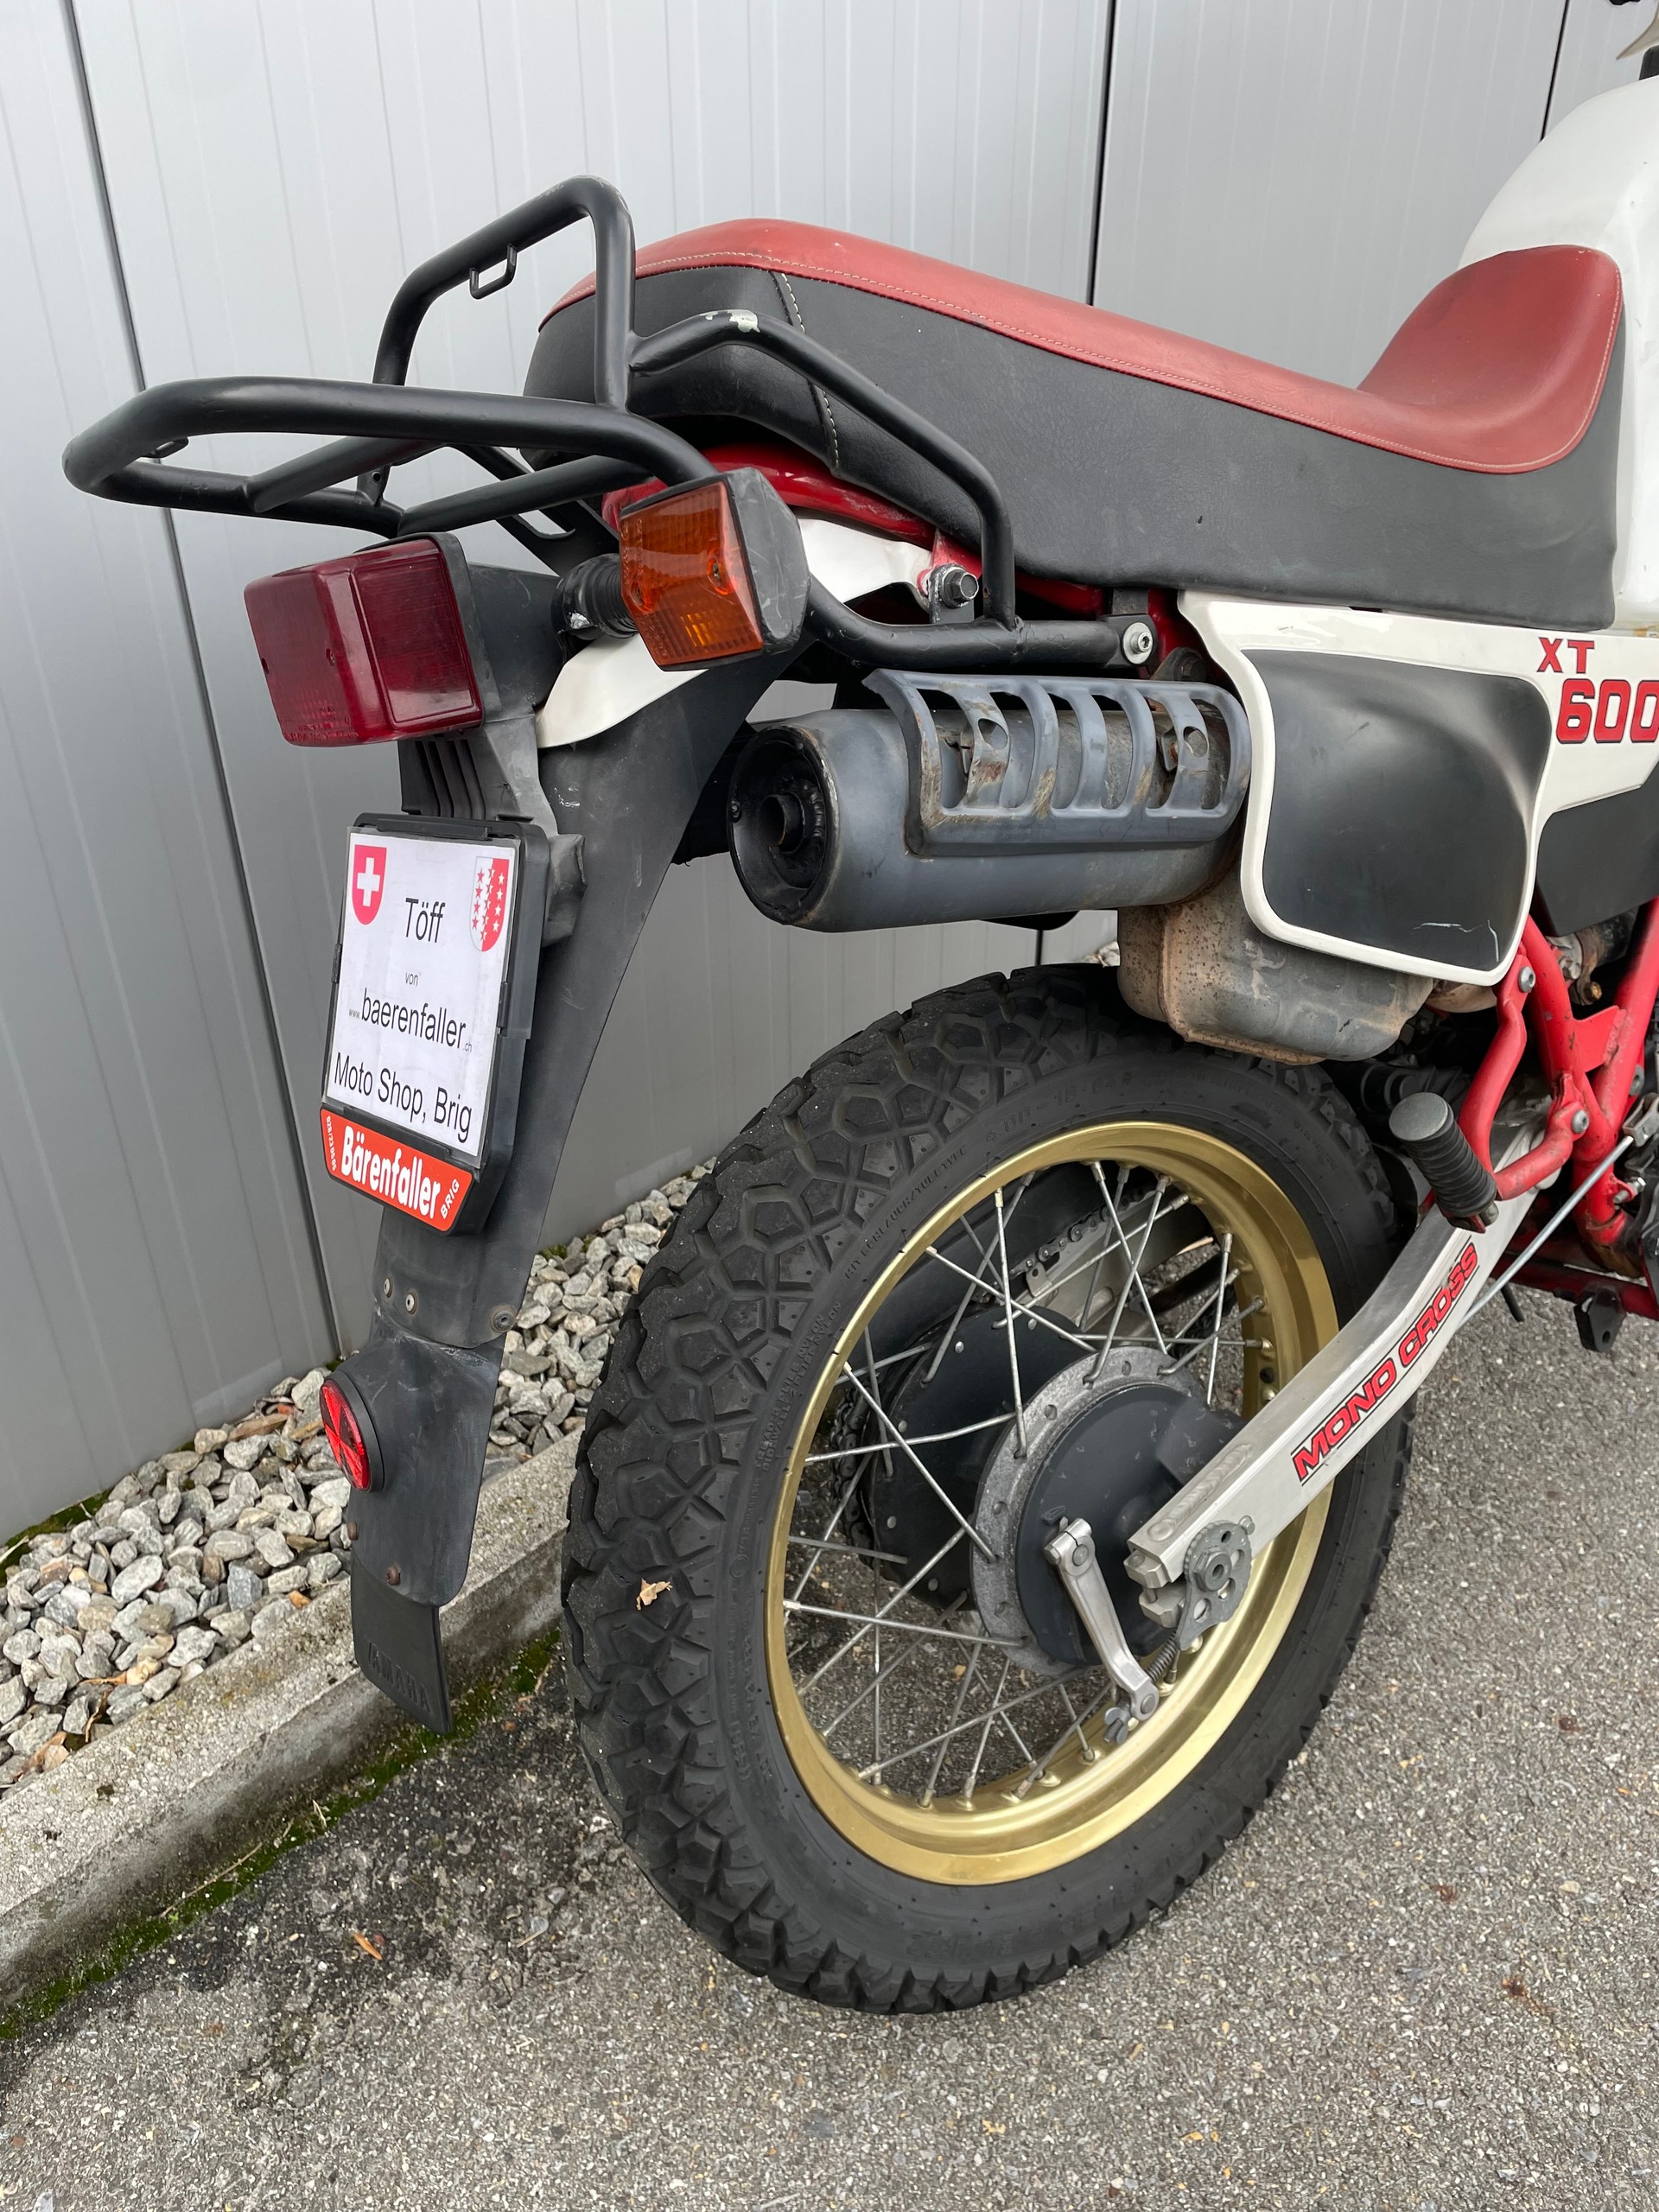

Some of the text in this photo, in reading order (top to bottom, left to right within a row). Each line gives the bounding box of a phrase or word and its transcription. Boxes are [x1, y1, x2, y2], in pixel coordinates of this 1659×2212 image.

[1536, 637, 1595, 674] XT
[1556, 677, 1659, 744] 600
[405, 897, 445, 944] Töff
[405, 972, 419, 987] von
[334, 1052, 472, 1143] Moto Shop, Brig
[341, 1126, 441, 1219] Bärenfaller
[441, 1179, 460, 1219] BRIG
[1292, 1242, 1478, 1483] MONO CROSS
